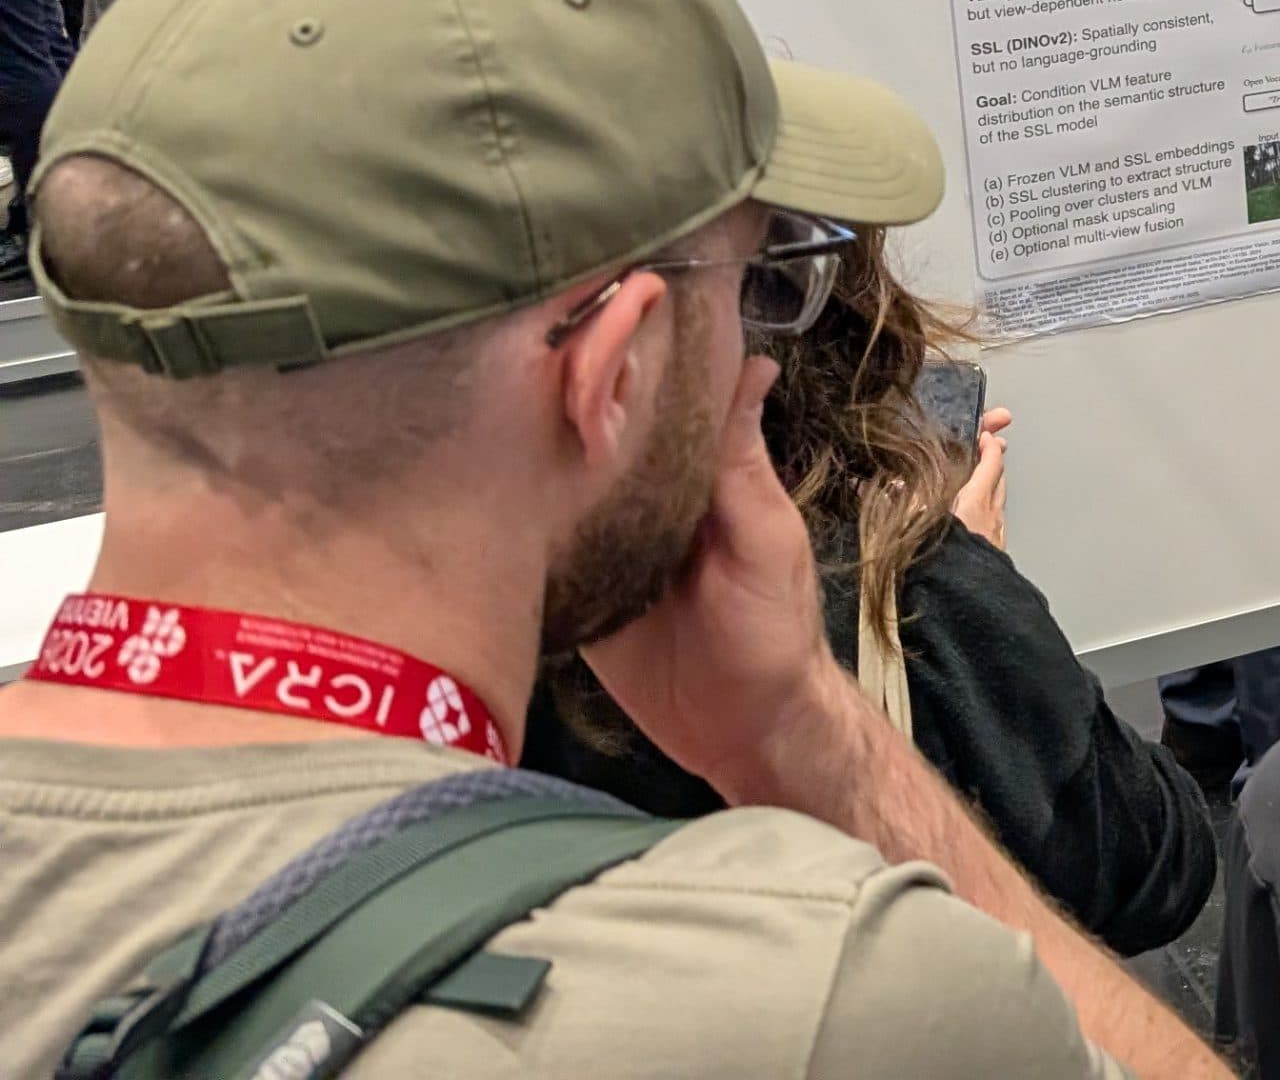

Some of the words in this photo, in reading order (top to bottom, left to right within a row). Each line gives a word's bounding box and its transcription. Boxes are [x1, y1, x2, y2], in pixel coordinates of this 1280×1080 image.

[976, 92, 1016, 108] Goal:
[1022, 84, 1086, 102] Condition
[1090, 76, 1120, 91] VLM
[1124, 72, 1172, 86] feature
[1258, 132, 1279, 142] Input
[230, 650, 395, 726] ICRA
